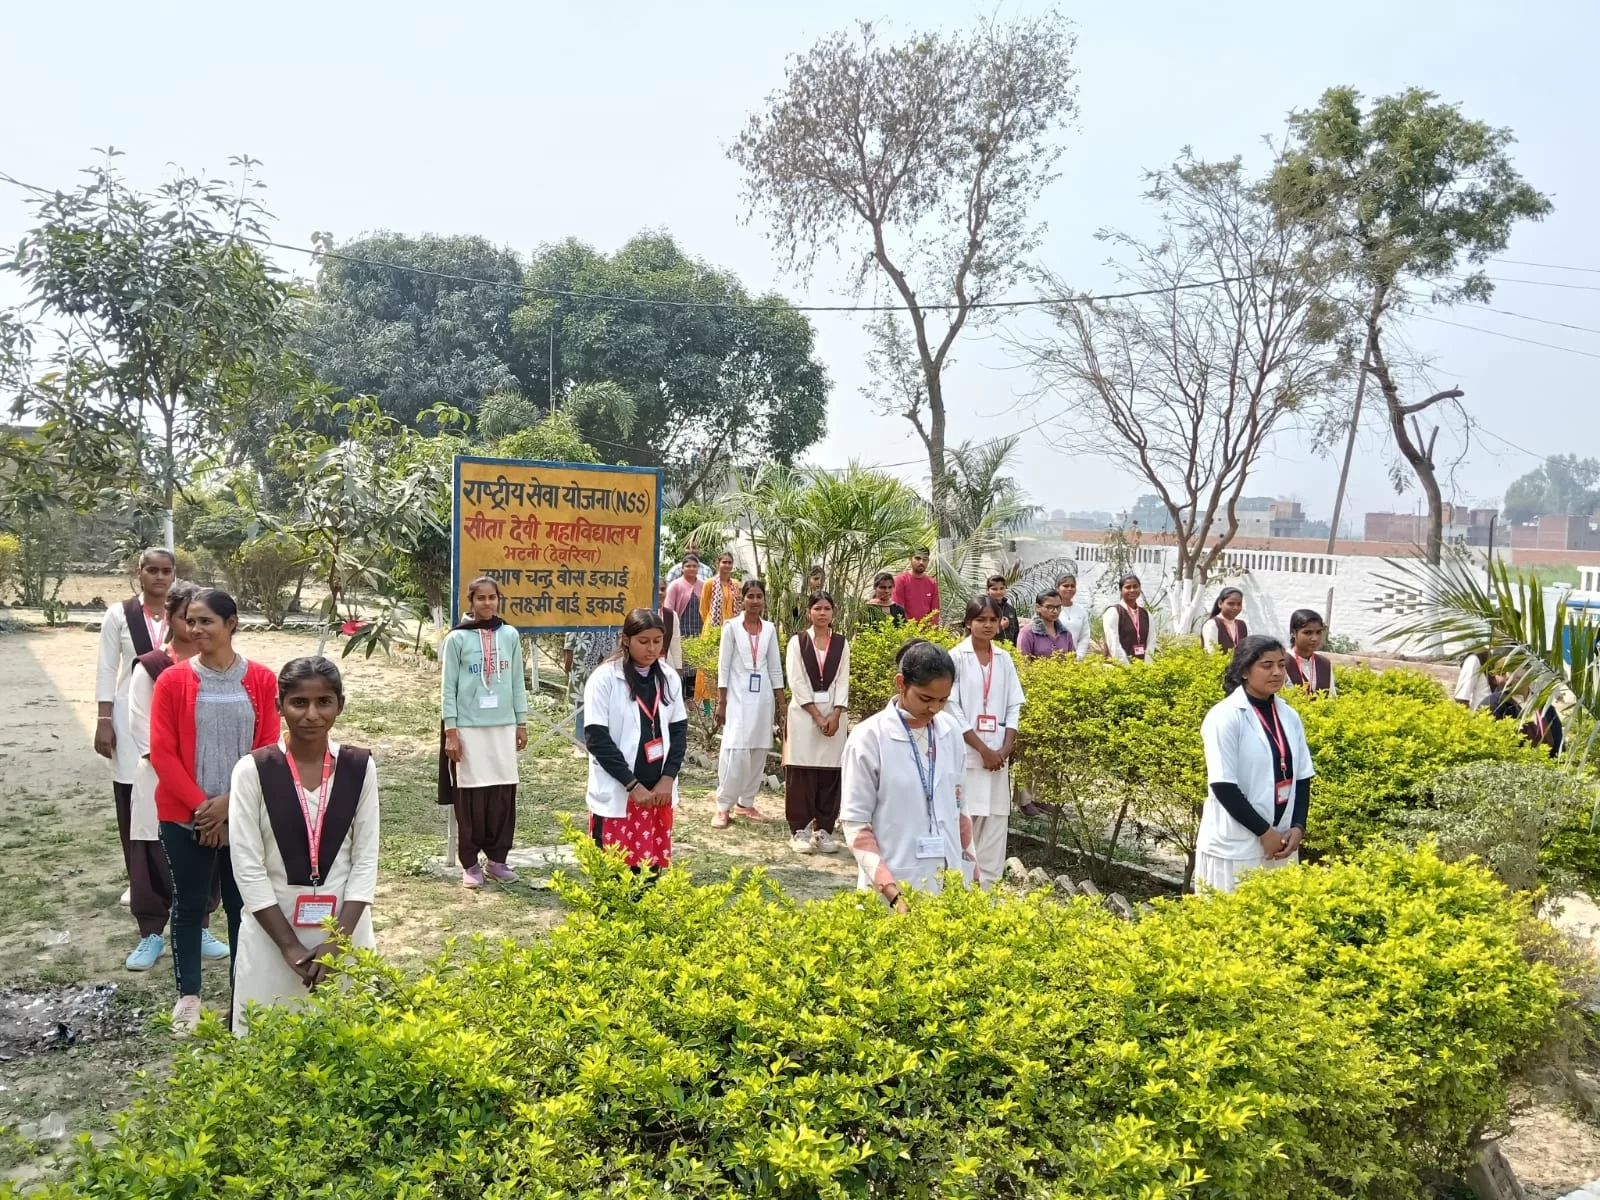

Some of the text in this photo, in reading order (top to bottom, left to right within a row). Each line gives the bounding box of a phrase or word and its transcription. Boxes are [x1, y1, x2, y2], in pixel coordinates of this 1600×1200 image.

[463, 475, 525, 511] राष्ट्रीय
[527, 477, 560, 509] सेवा
[464, 511, 642, 546] सीता देवी महाविद्यालय
[503, 543, 602, 567] भटनी (देवरिया)
[525, 569, 556, 589] चन्द्र
[557, 564, 587, 587] बोस
[588, 565, 629, 589] इकाई
[510, 591, 553, 616] लक्ष्मी
[556, 591, 582, 616] बाई
[585, 591, 627, 617] इकाई
